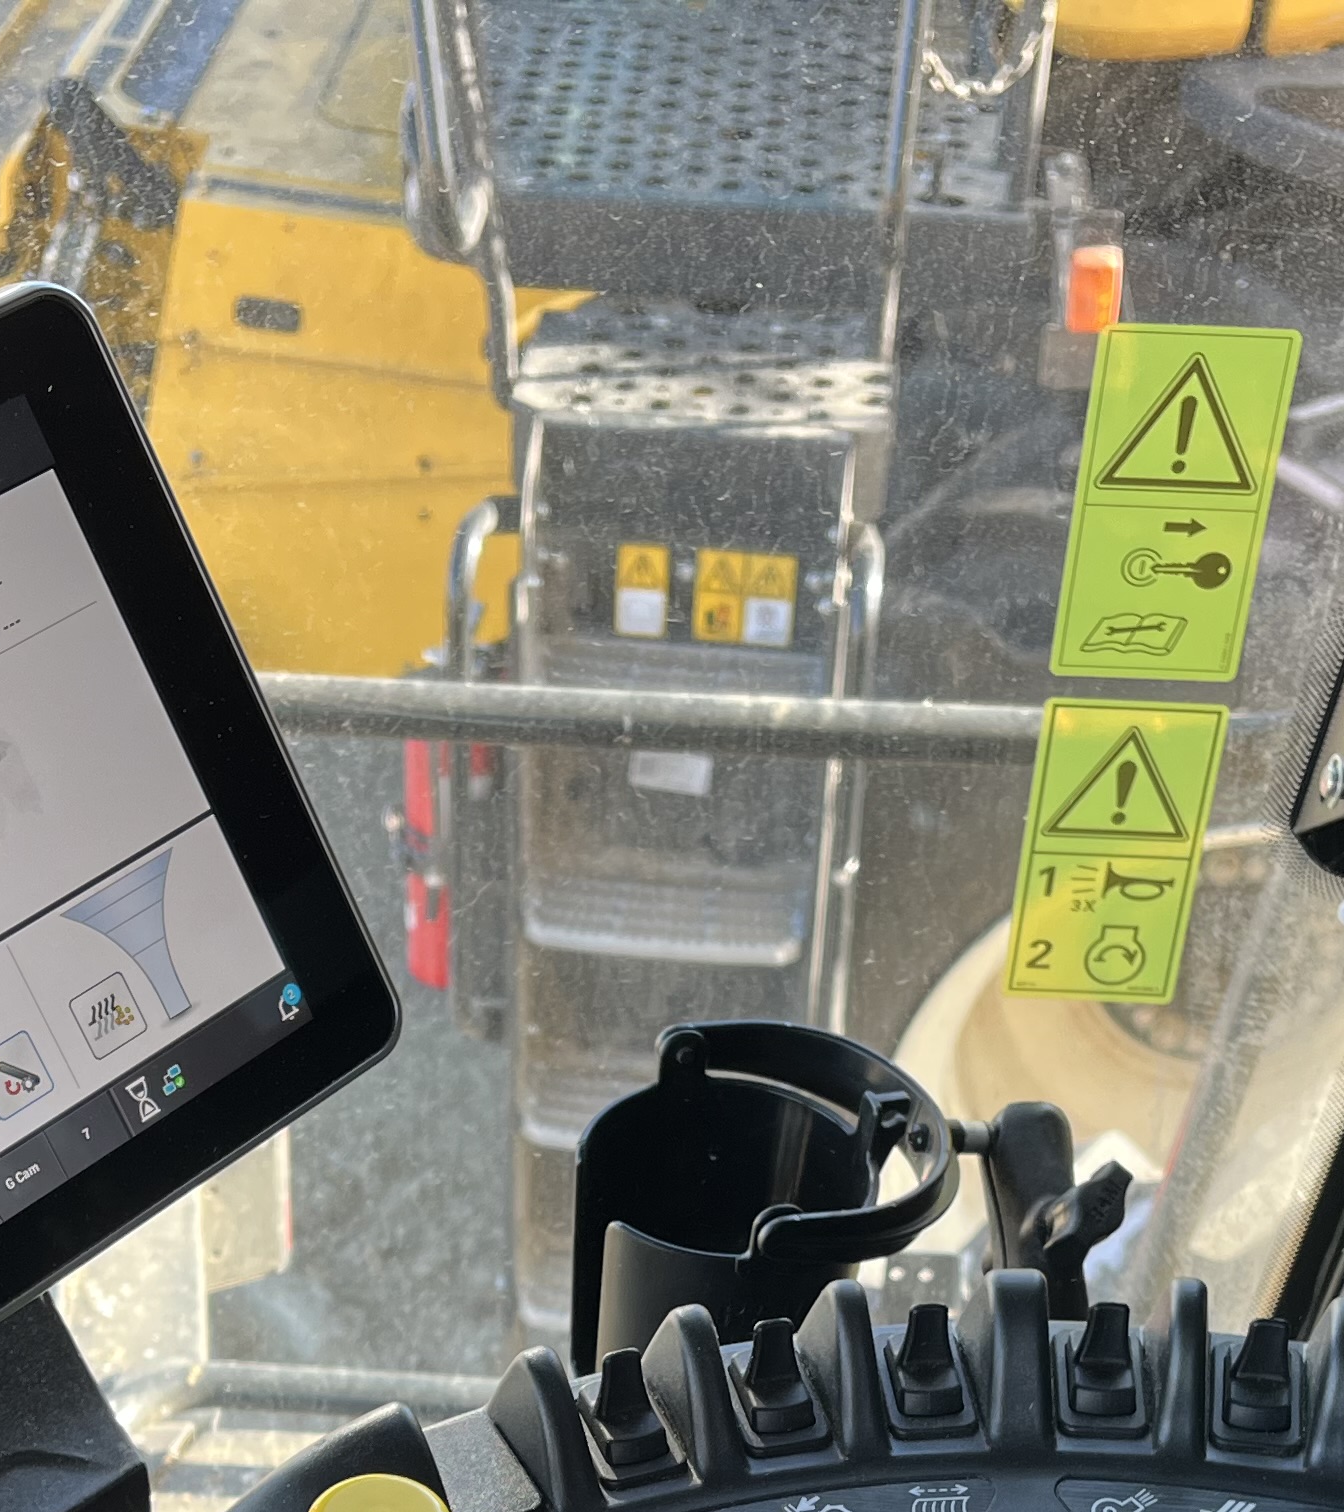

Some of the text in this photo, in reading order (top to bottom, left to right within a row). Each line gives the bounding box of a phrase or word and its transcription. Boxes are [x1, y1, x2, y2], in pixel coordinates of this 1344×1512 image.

[1039, 866, 1056, 897] 1
[1025, 939, 1053, 969] 2
[286, 989, 296, 1000] 2
[15, 1162, 41, 1184] Cam
